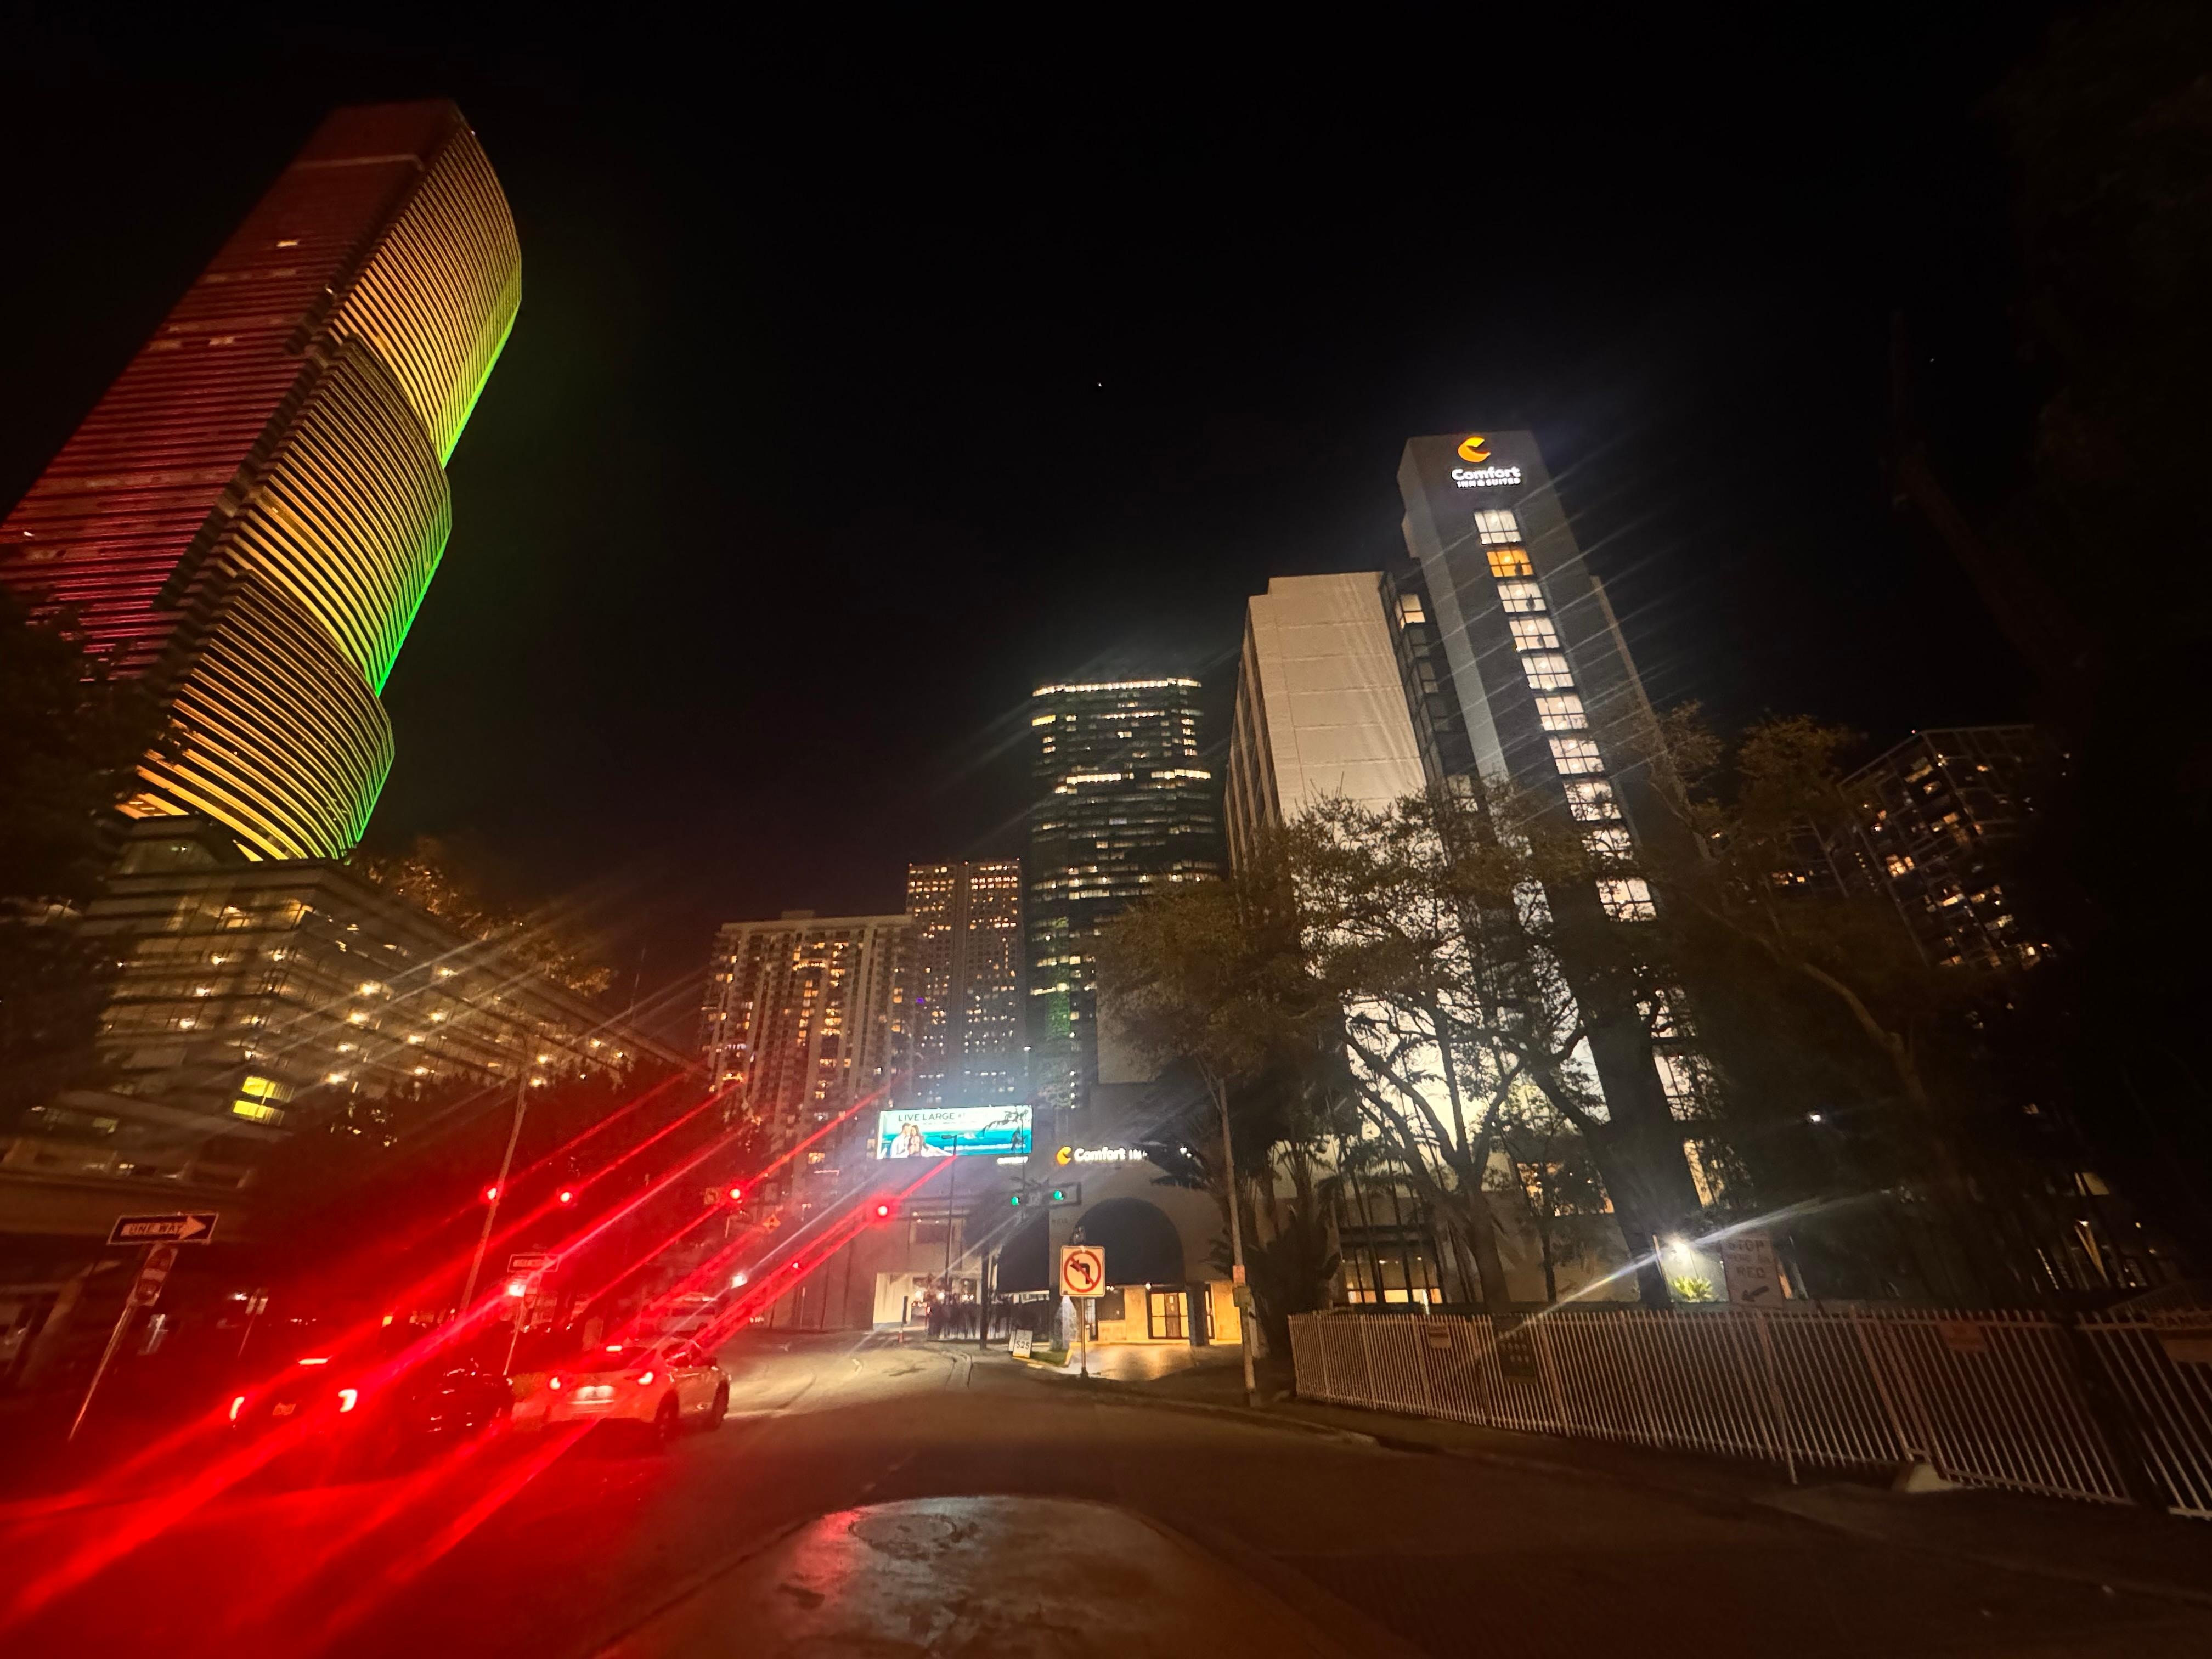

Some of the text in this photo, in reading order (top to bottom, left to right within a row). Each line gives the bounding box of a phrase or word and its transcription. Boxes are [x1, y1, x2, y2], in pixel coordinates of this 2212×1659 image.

[1451, 467, 1520, 481] Comfort
[922, 1112, 955, 1121] LARGE
[1074, 1146, 1126, 1161] Comfort
[1016, 1340, 1030, 1350] $25
